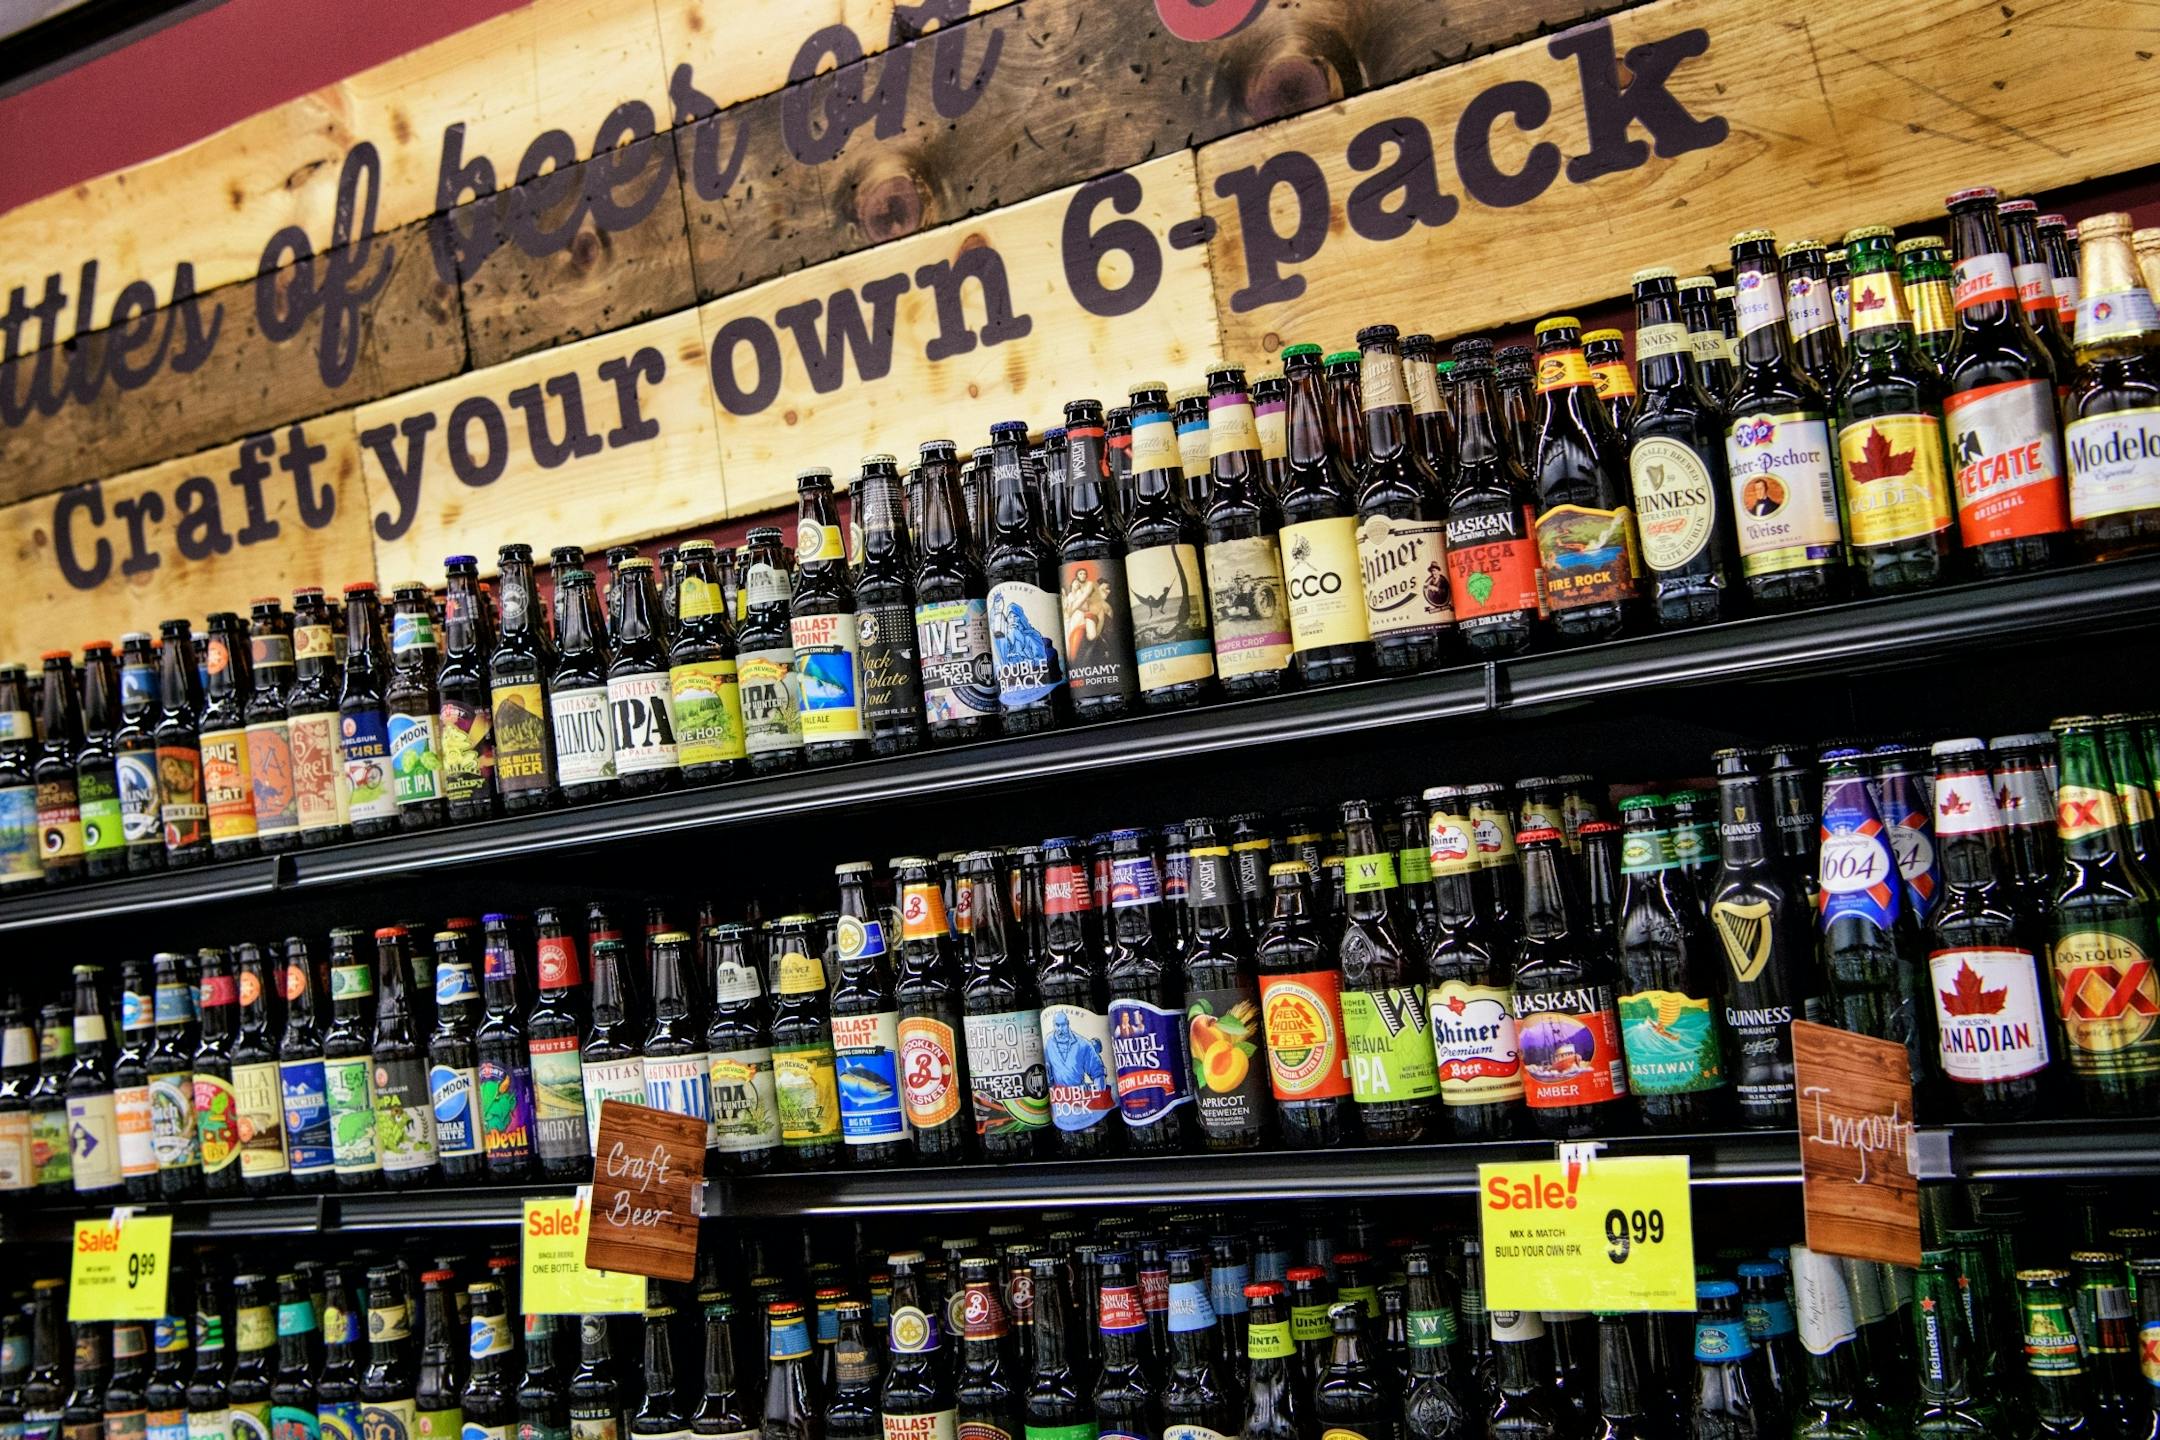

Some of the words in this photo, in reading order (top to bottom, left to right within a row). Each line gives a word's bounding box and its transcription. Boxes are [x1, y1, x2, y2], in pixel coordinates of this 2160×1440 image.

[255, 141, 397, 388] of
[430, 61, 749, 287] beer
[780, 0, 1005, 165] on
[52, 424, 339, 591] Craft
[361, 344, 667, 542] your
[709, 243, 1034, 416] own
[1061, 17, 1731, 318] 6-pack
[1071, 440, 1085, 480] WASATCH
[1955, 440, 2043, 498] TECATE
[1662, 508, 1690, 519] STOUT
[1974, 496, 2024, 521] ORIGINAL
[1683, 517, 1705, 550] DUBLIN
[1459, 559, 1502, 578] PALE
[1549, 578, 1572, 592] FIRE
[1575, 571, 1611, 587] ROCK
[1478, 612, 1512, 626] DRAFT
[795, 631, 830, 646] POINT
[1242, 637, 1265, 648] CROP
[1159, 646, 1178, 658] DUTY
[1246, 649, 1265, 660] ALE
[996, 658, 1050, 680] DOUBLE
[941, 673, 973, 686] TIER
[999, 673, 1045, 695] BLACK
[1084, 675, 1119, 685] PORTER
[611, 695, 677, 751] IPA
[817, 715, 830, 724] ALE
[400, 725, 428, 745] MOON
[696, 726, 723, 739] HOP
[513, 753, 541, 763] BUTTE
[415, 774, 432, 791] IPA
[207, 787, 243, 802] HEAT
[1776, 814, 1814, 828] GUINNESS
[1721, 822, 1762, 836] GUINNESS
[1822, 849, 1882, 882] 1664
[1201, 859, 1216, 901] WASATCH
[1240, 855, 1257, 895] WASATCH
[2058, 951, 2081, 963] DOS
[2086, 947, 2132, 962] EQUIS
[1275, 1010, 1300, 1020] RED
[1726, 1006, 1791, 1026] GUINNESS
[1272, 1020, 1308, 1031] HOOK
[1435, 1016, 1501, 1047] Shiner
[1739, 1026, 1776, 1035] DRAUGHT
[836, 1033, 871, 1047] POINT
[1278, 1034, 1303, 1045] ESB
[1440, 1045, 1494, 1058] Premium
[1450, 1063, 1483, 1077] Beer
[1632, 1061, 1695, 1075] CASTAWAY
[442, 1077, 471, 1096] MOON
[1137, 1074, 1170, 1086] LAGER
[991, 1086, 1024, 1099] TIER
[1049, 1083, 1101, 1102] DOUBLE
[1536, 1086, 1580, 1098] AMBER
[1768, 1084, 1793, 1092] DUBLIN
[1055, 1100, 1092, 1117] BOCK
[1202, 1095, 1245, 1108] APRICOT
[848, 1118, 858, 1126] BIG
[859, 1117, 872, 1126] EYE
[538, 1120, 574, 1141] MORY
[607, 1142, 671, 1192] Craft
[1488, 1162, 1581, 1210] Sale!
[529, 1196, 584, 1236] Sale!
[606, 1190, 672, 1227] Beer
[79, 1227, 120, 1252] Sale!
[1510, 1230, 1524, 1239] MIX
[1527, 1230, 1533, 1238] &
[1536, 1229, 1566, 1238] MATCH
[1495, 1246, 1520, 1257] BUILD
[1522, 1246, 1544, 1257] YOUR
[1547, 1245, 1564, 1256] OWN
[1566, 1244, 1582, 1256] 6PK
[533, 1264, 549, 1273] ONE
[551, 1263, 579, 1273] BOTTLE
[1101, 1293, 1130, 1304] SAMUEL
[1923, 1315, 1942, 1380] Heineken
[884, 1416, 936, 1432] BALLAST
